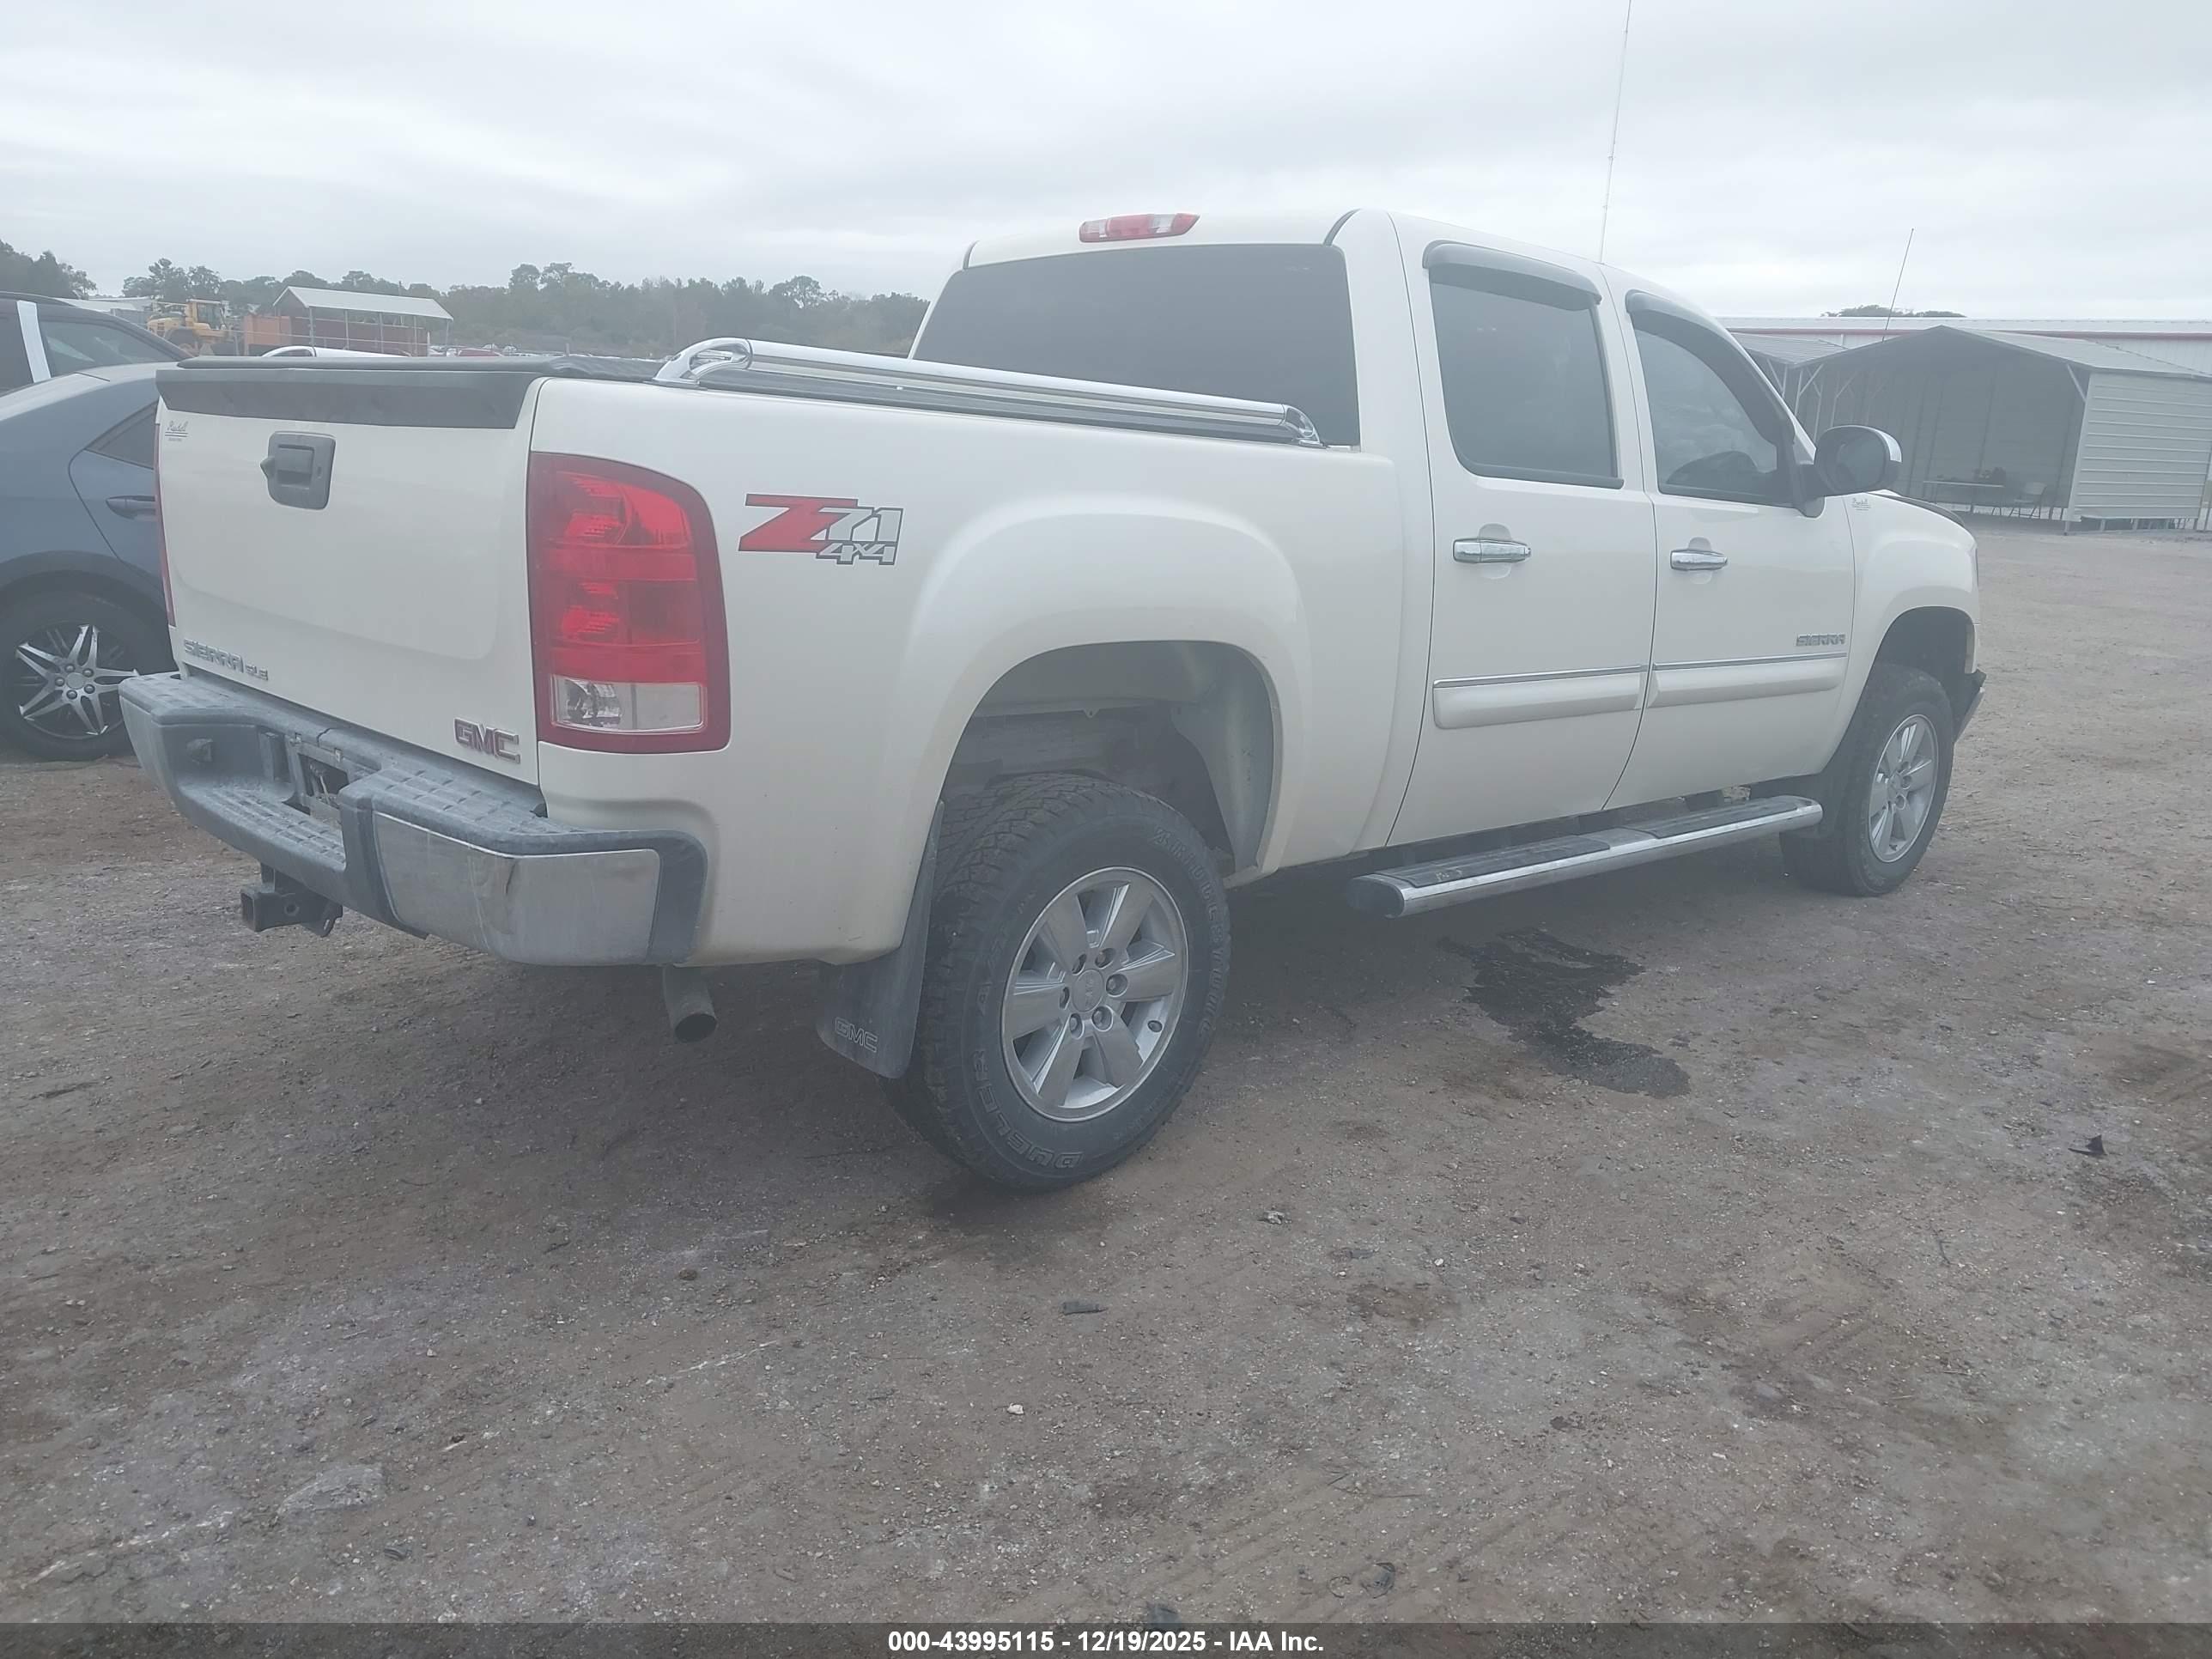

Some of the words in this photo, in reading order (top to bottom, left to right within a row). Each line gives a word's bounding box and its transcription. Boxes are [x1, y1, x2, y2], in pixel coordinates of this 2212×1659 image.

[738, 493, 903, 552] Z71
[184, 639, 244, 673] SIERRA
[1795, 634, 1846, 646] SIERRA
[453, 717, 520, 764] GMC
[835, 1017, 878, 1053] GMC
